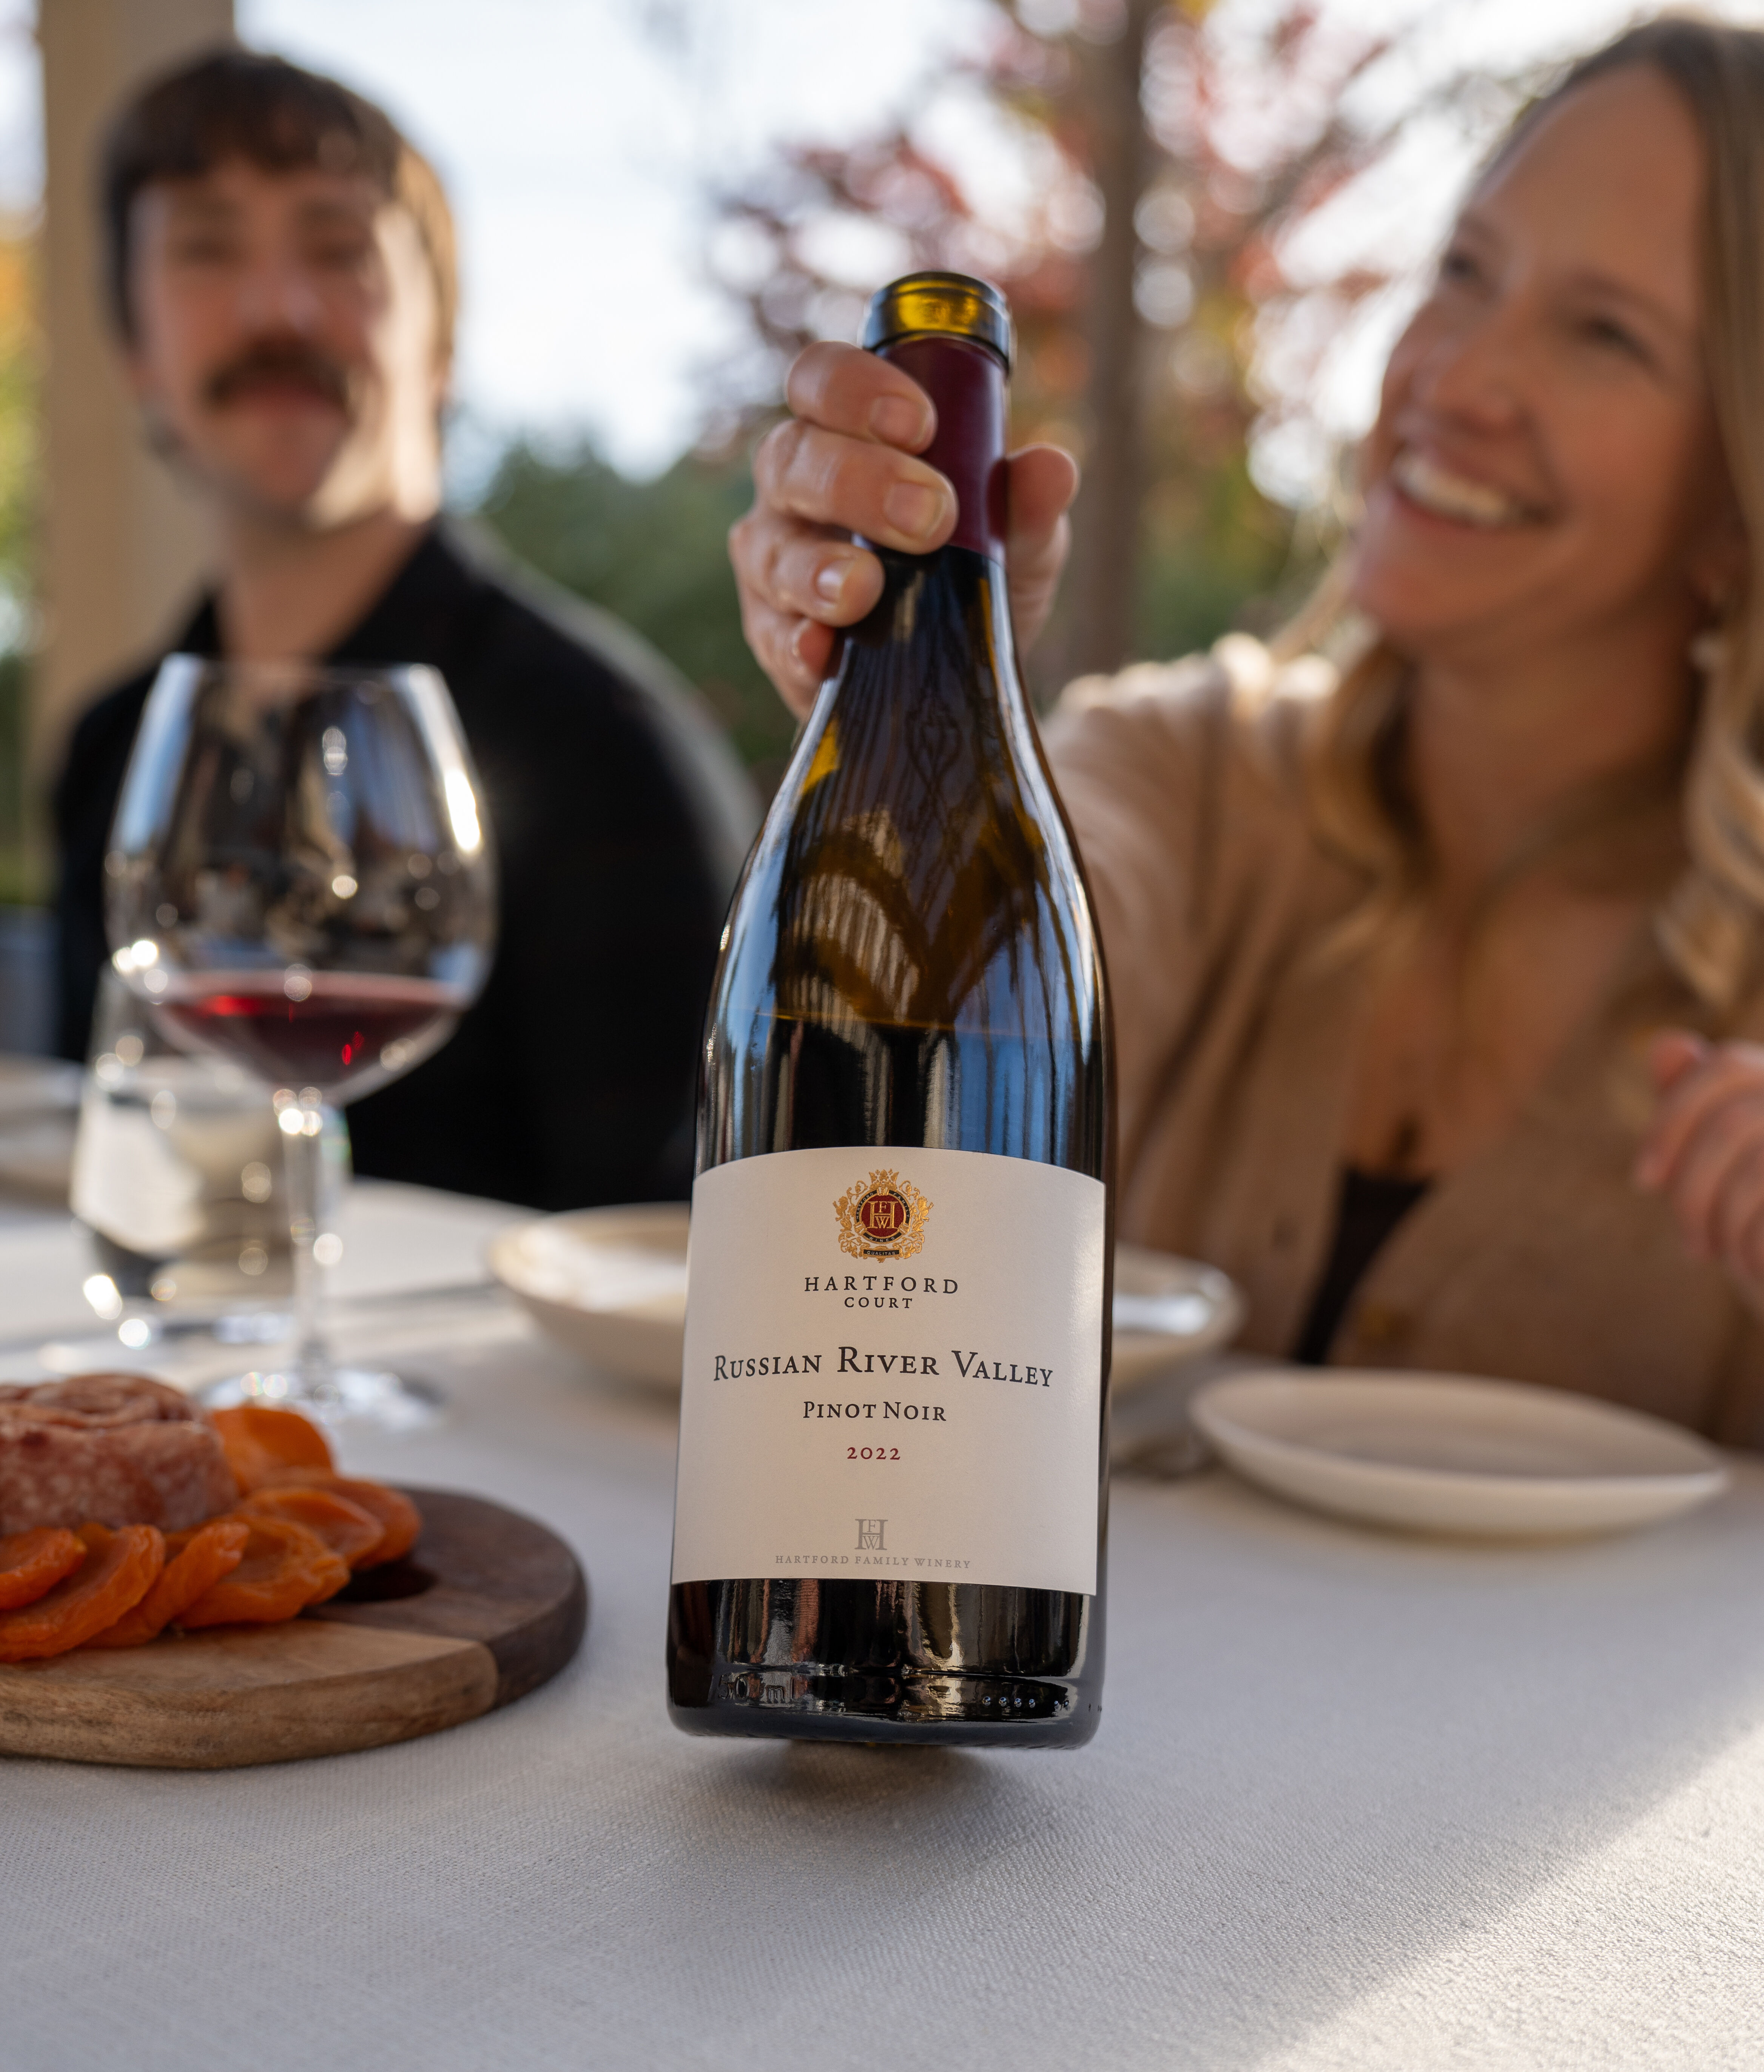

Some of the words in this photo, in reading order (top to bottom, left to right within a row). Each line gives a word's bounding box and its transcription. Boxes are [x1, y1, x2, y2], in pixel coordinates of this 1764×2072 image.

[856, 1192, 873, 1219] HARTFORD
[893, 1192, 910, 1218] FAMILY
[804, 1275, 958, 1294] HARTFORD
[844, 1297, 913, 1309] COURT
[713, 1355, 822, 1381] RUSSIAN
[837, 1346, 940, 1375] RIVER
[951, 1350, 1053, 1388] VALLEY
[803, 1401, 877, 1418] PINOT
[883, 1401, 947, 1421] NOIR
[847, 1447, 901, 1460] 2022
[775, 1555, 849, 1564] HARTFORD
[854, 1556, 909, 1566] FAMILY
[914, 1558, 971, 1569] WINERY
